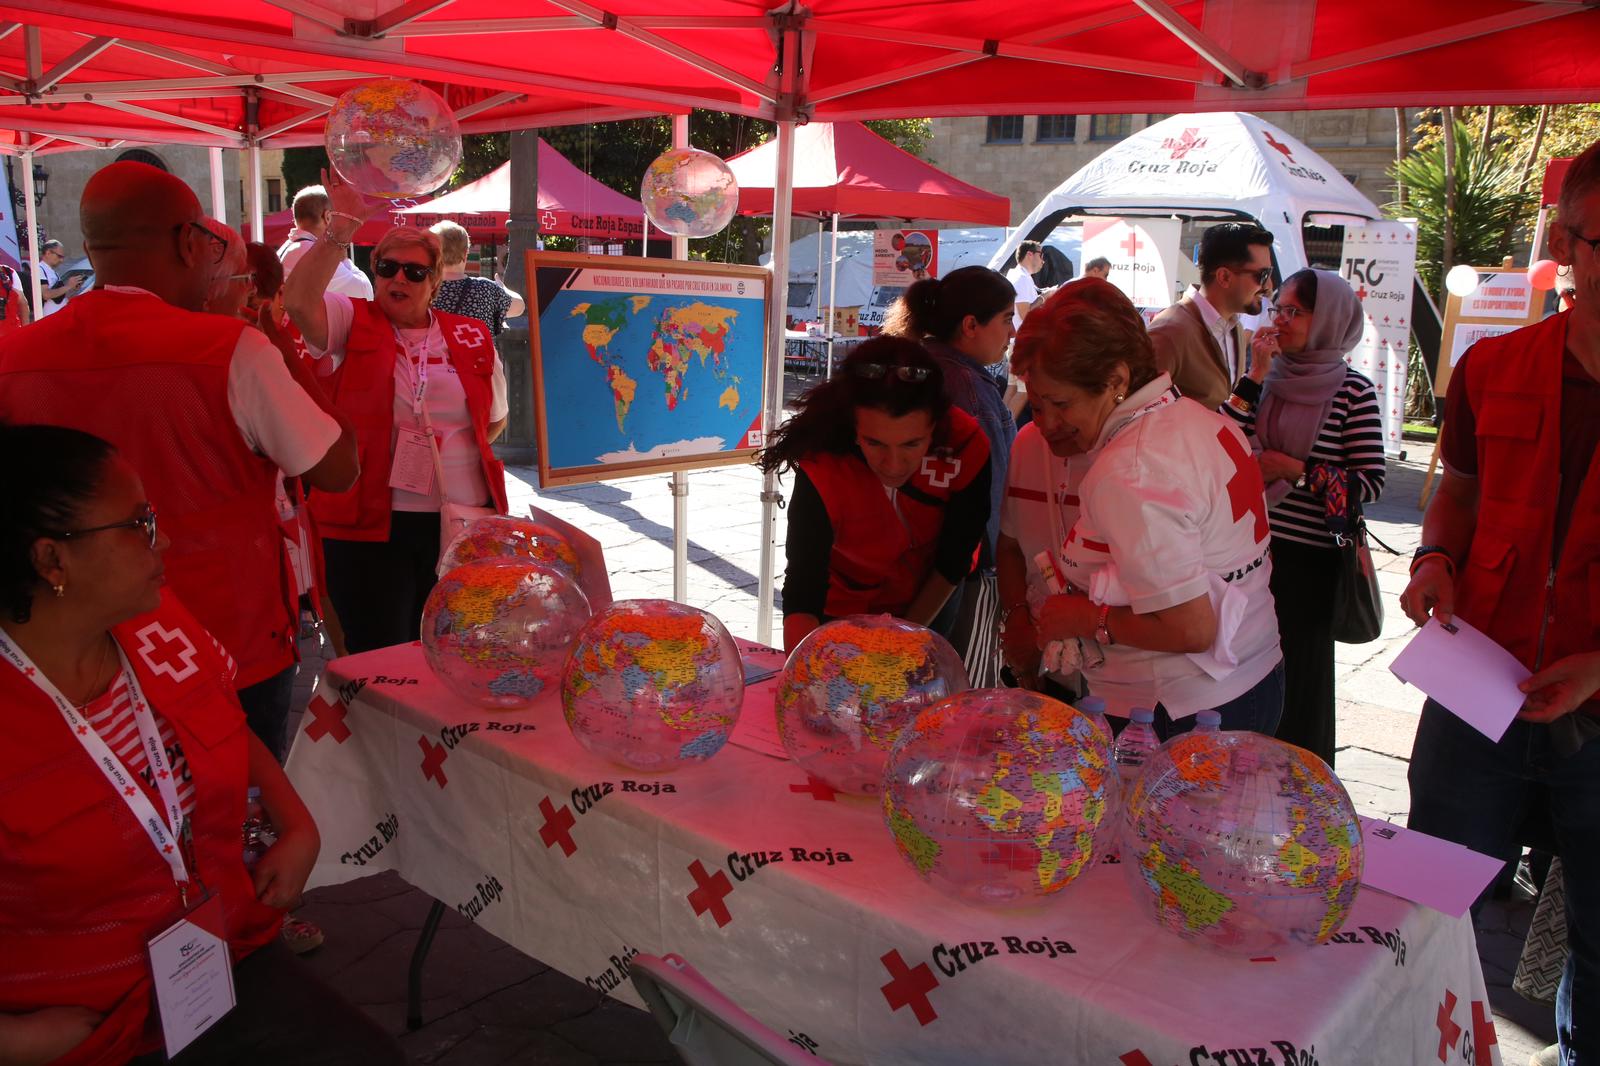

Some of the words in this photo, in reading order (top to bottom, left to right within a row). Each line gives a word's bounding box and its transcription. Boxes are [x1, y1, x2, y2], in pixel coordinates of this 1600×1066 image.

[1128, 160, 1170, 173] Cruz
[1176, 160, 1218, 177] Roja
[571, 215, 594, 229] Cruz
[596, 216, 616, 234] Roja
[618, 217, 656, 237] Españla
[1110, 263, 1129, 271] ruz
[1133, 263, 1155, 273] Roja
[1370, 290, 1387, 299] Cruz
[1390, 291, 1405, 302] Roja
[339, 677, 368, 706] Cruz
[372, 675, 418, 686] Roja
[148, 736, 157, 752] Roja
[441, 722, 480, 750] Cruz
[486, 721, 536, 734] Roja
[103, 756, 115, 772] Roja
[153, 751, 162, 767] Cruz
[113, 770, 126, 785] Cruz
[571, 782, 614, 815] Cruz
[621, 780, 677, 795] Roja
[340, 836, 384, 866] Cruz
[376, 812, 399, 844] Roja
[727, 851, 784, 882] Cruz
[789, 847, 854, 866] Roja
[476, 874, 504, 907] Roja
[932, 943, 999, 978] Cruz
[1001, 936, 1077, 959] Roja
[1324, 931, 1365, 946] uz
[1358, 926, 1406, 967] Roja
[788, 1029, 819, 1056] ja
